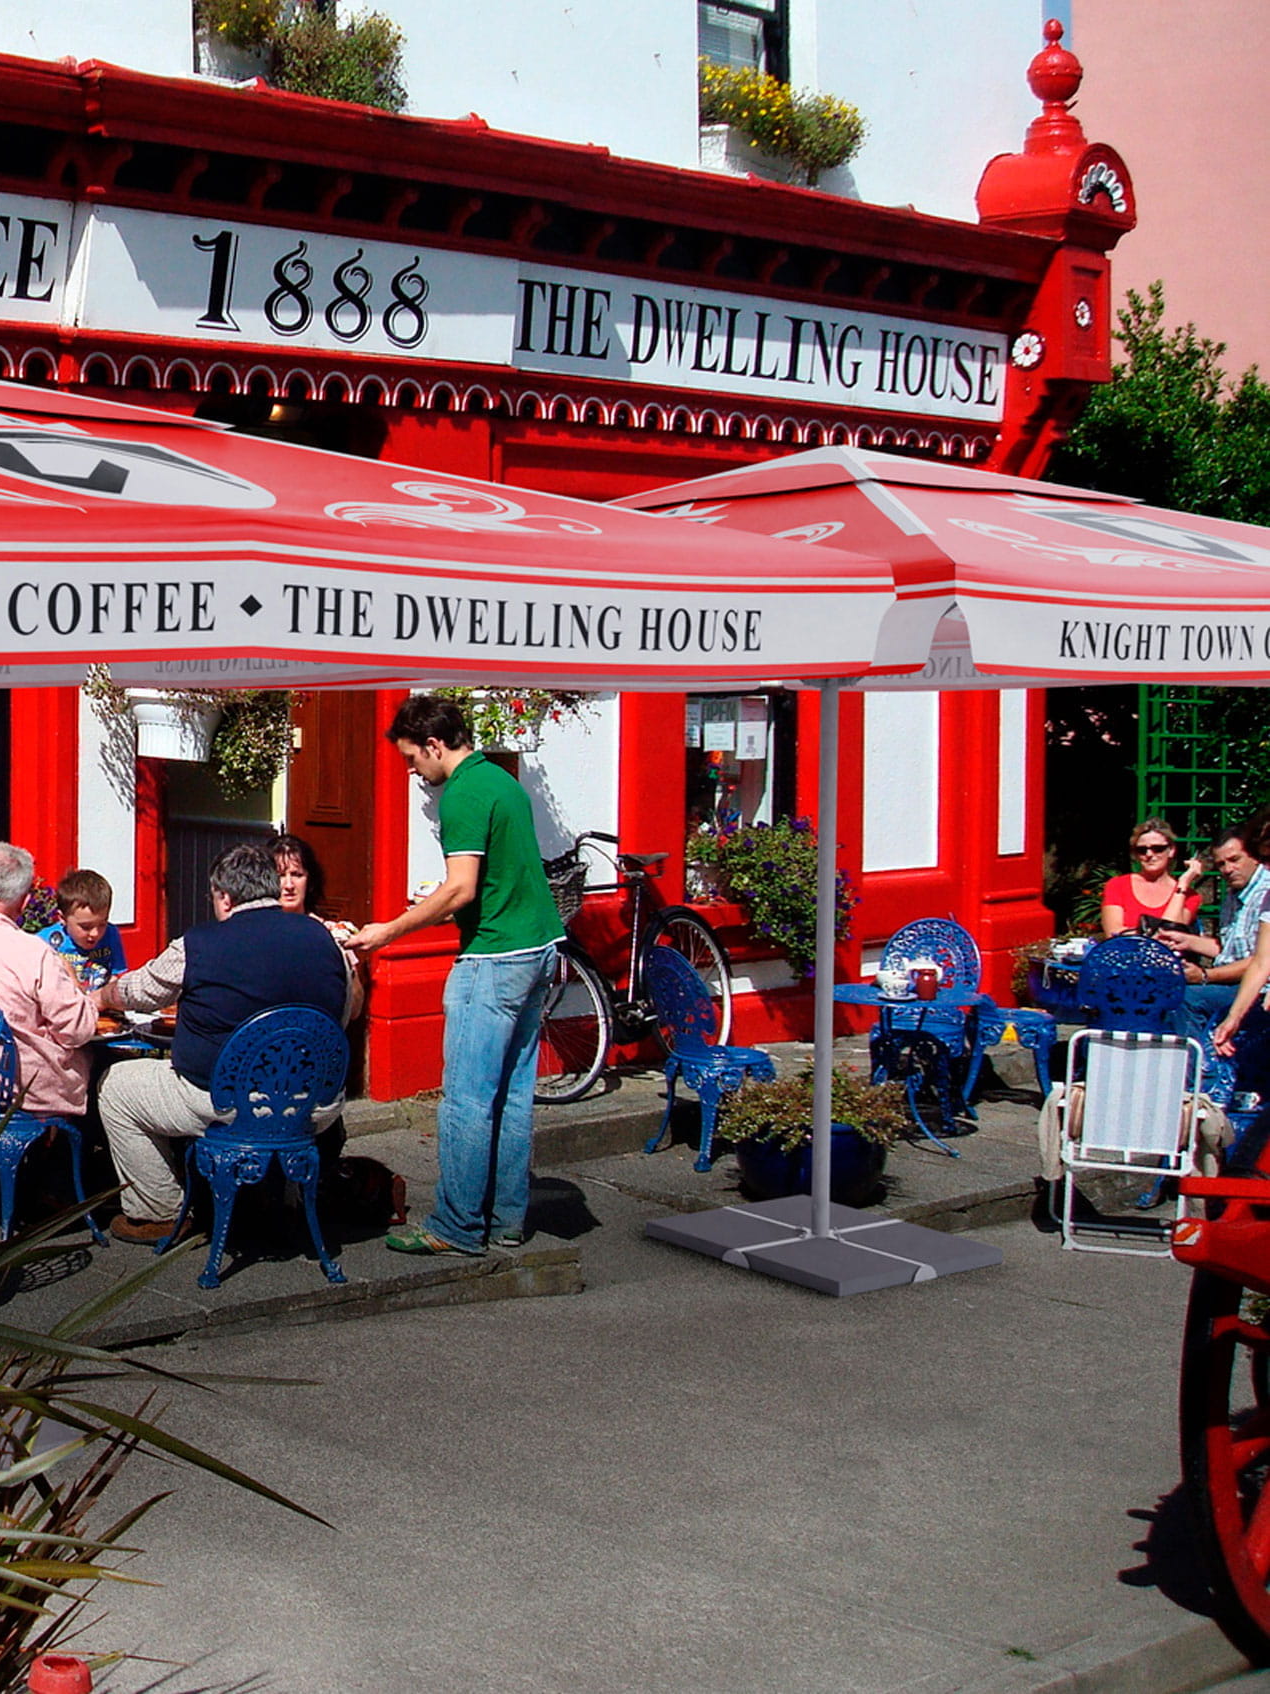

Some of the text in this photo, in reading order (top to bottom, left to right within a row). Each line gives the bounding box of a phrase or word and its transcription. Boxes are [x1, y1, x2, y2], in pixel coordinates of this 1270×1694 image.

[192, 229, 430, 350] 1888
[515, 278, 1000, 406] THE DWELLING HOUSE
[7, 581, 217, 636] COFFEE
[282, 583, 374, 640] THE
[393, 592, 623, 651] DWELLING
[638, 606, 763, 653] HOUSE
[1059, 620, 1171, 661] KNIGHT
[1180, 624, 1255, 662] TOWN
